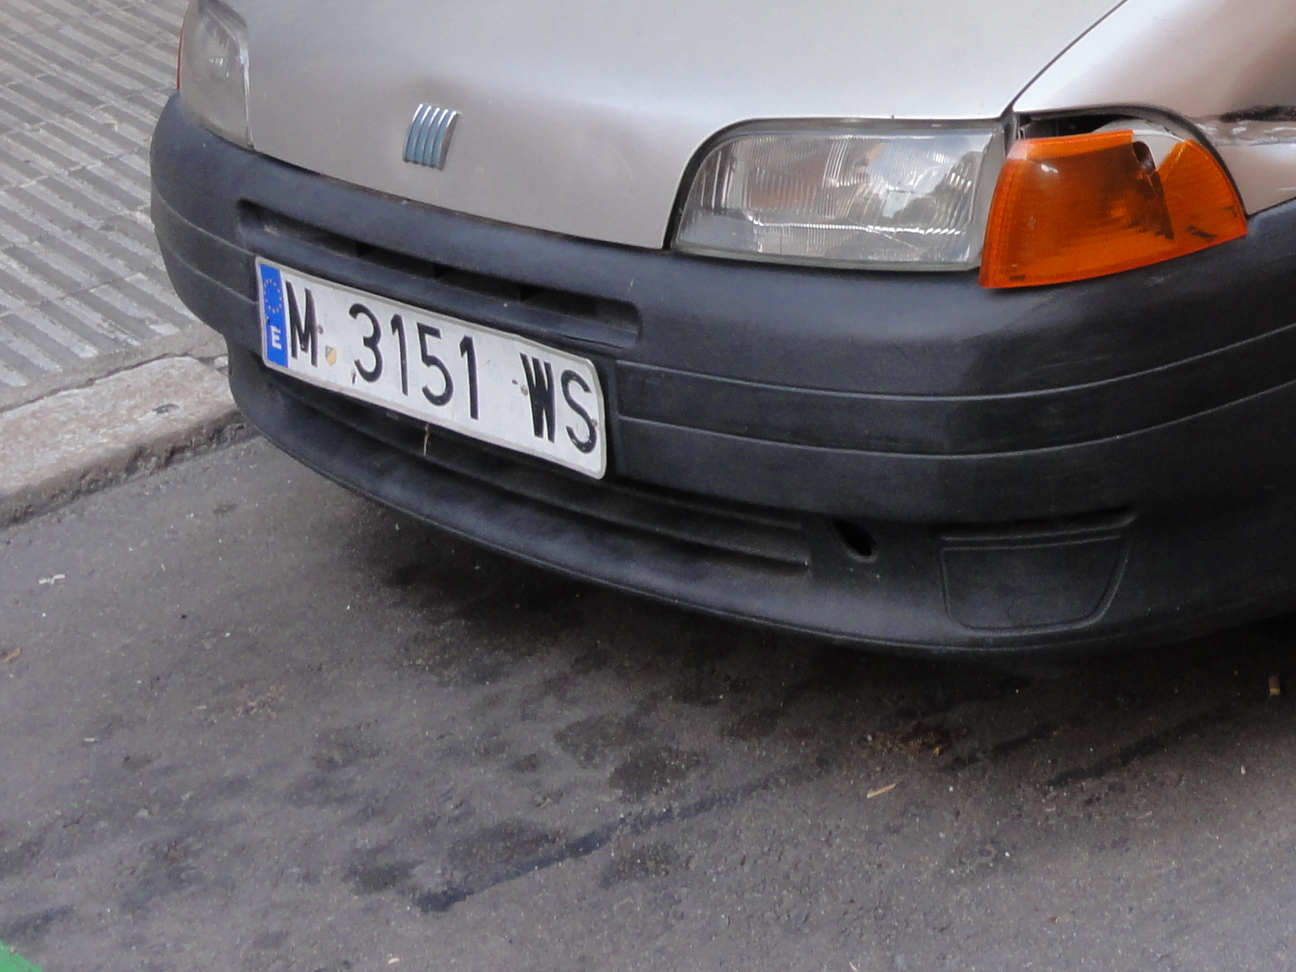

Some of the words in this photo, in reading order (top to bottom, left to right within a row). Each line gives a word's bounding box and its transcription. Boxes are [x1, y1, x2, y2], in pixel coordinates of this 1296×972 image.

[271, 325, 282, 350] E
[284, 280, 319, 367] M
[349, 302, 480, 420] 3151
[519, 351, 598, 455] WS
